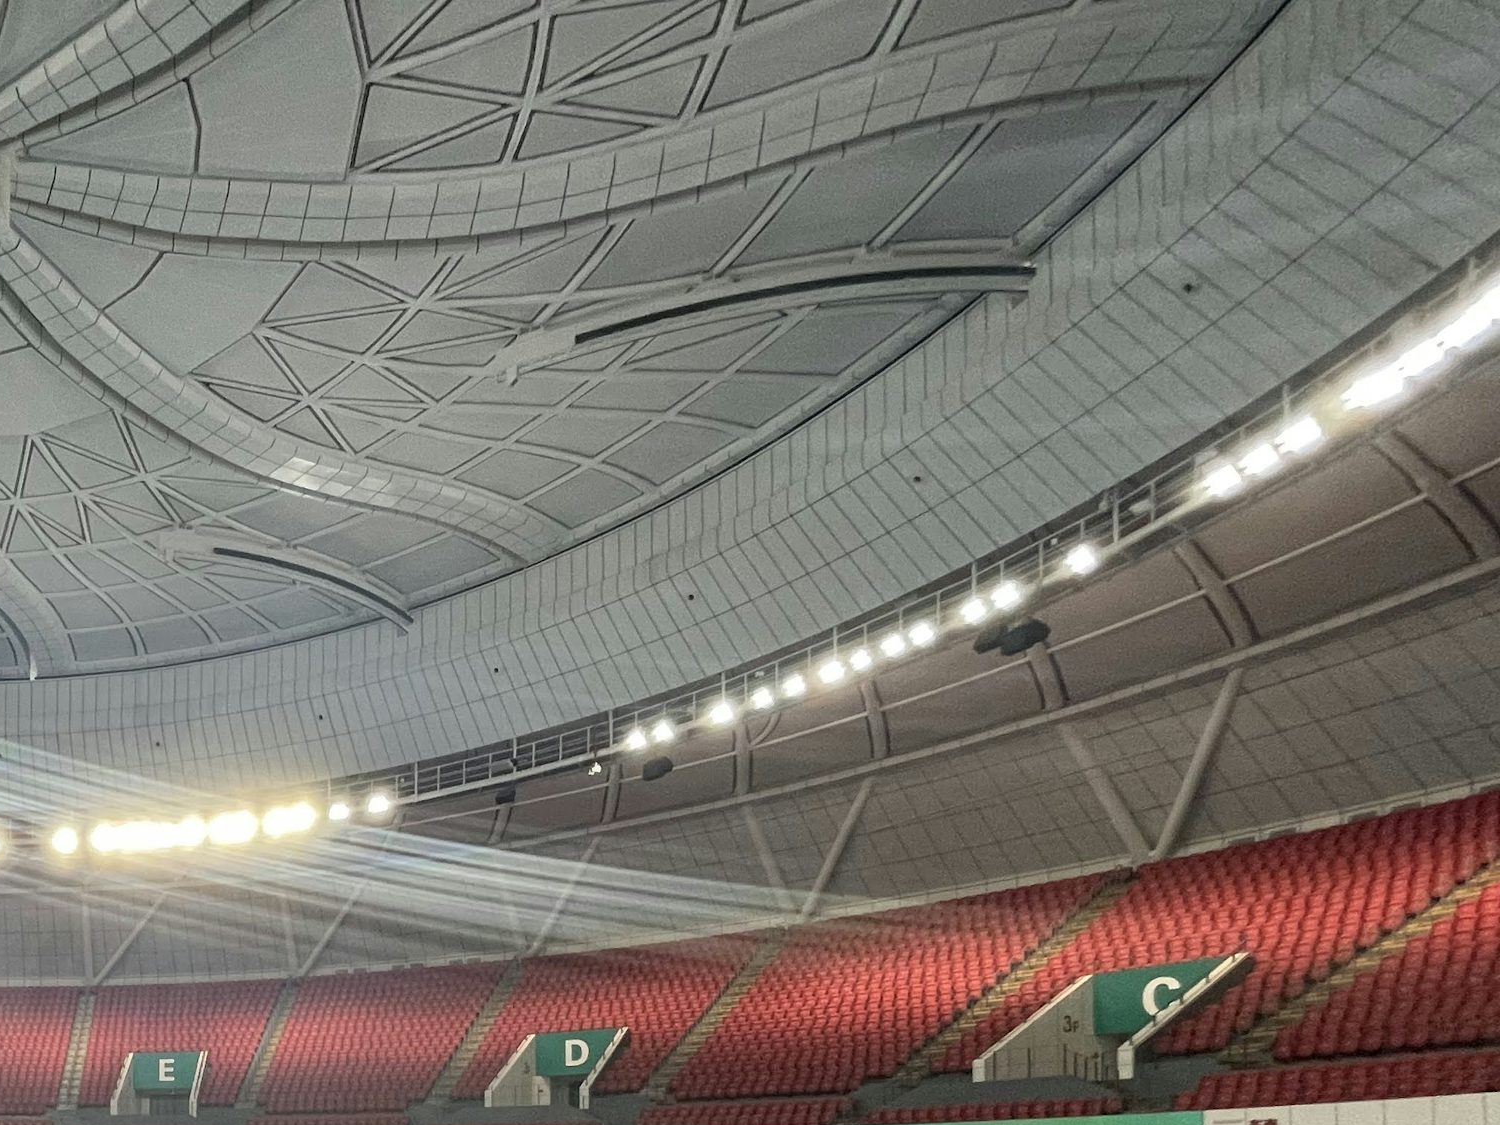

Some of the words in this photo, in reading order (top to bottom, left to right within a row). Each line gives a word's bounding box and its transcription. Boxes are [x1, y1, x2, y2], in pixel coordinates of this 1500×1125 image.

[1142, 976, 1181, 1016] C
[564, 1038, 590, 1067] D
[158, 1058, 175, 1082] E
